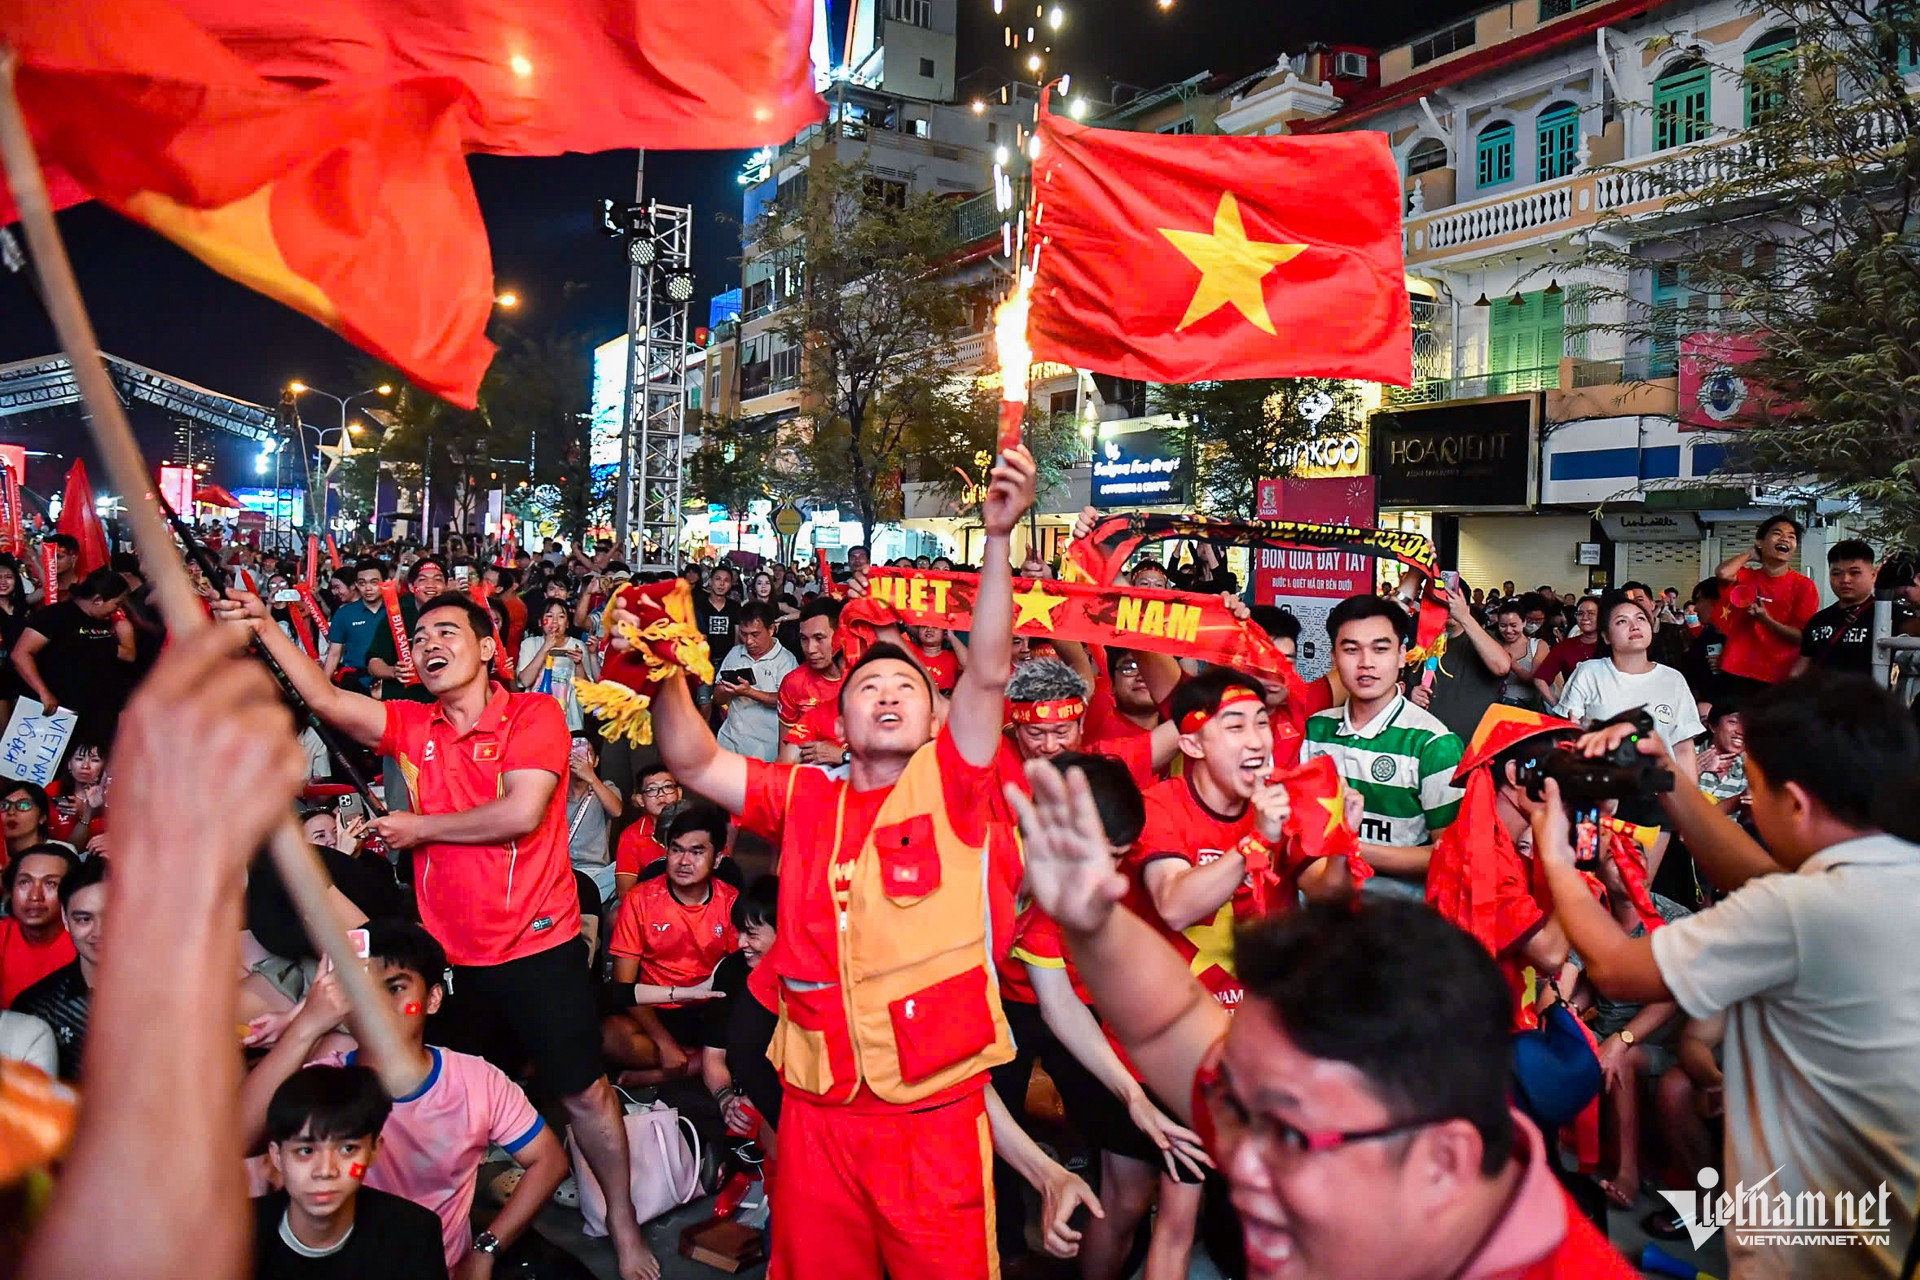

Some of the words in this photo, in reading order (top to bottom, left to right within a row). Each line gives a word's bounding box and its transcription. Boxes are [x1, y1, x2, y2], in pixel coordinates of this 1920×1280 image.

[48, 559, 58, 592] SAIGON
[1292, 577, 1307, 589] QUÉT
[1316, 579, 1325, 590] QR
[869, 574, 952, 617] VIỆT
[1115, 596, 1202, 643] NAM
[392, 614, 401, 631] BIA
